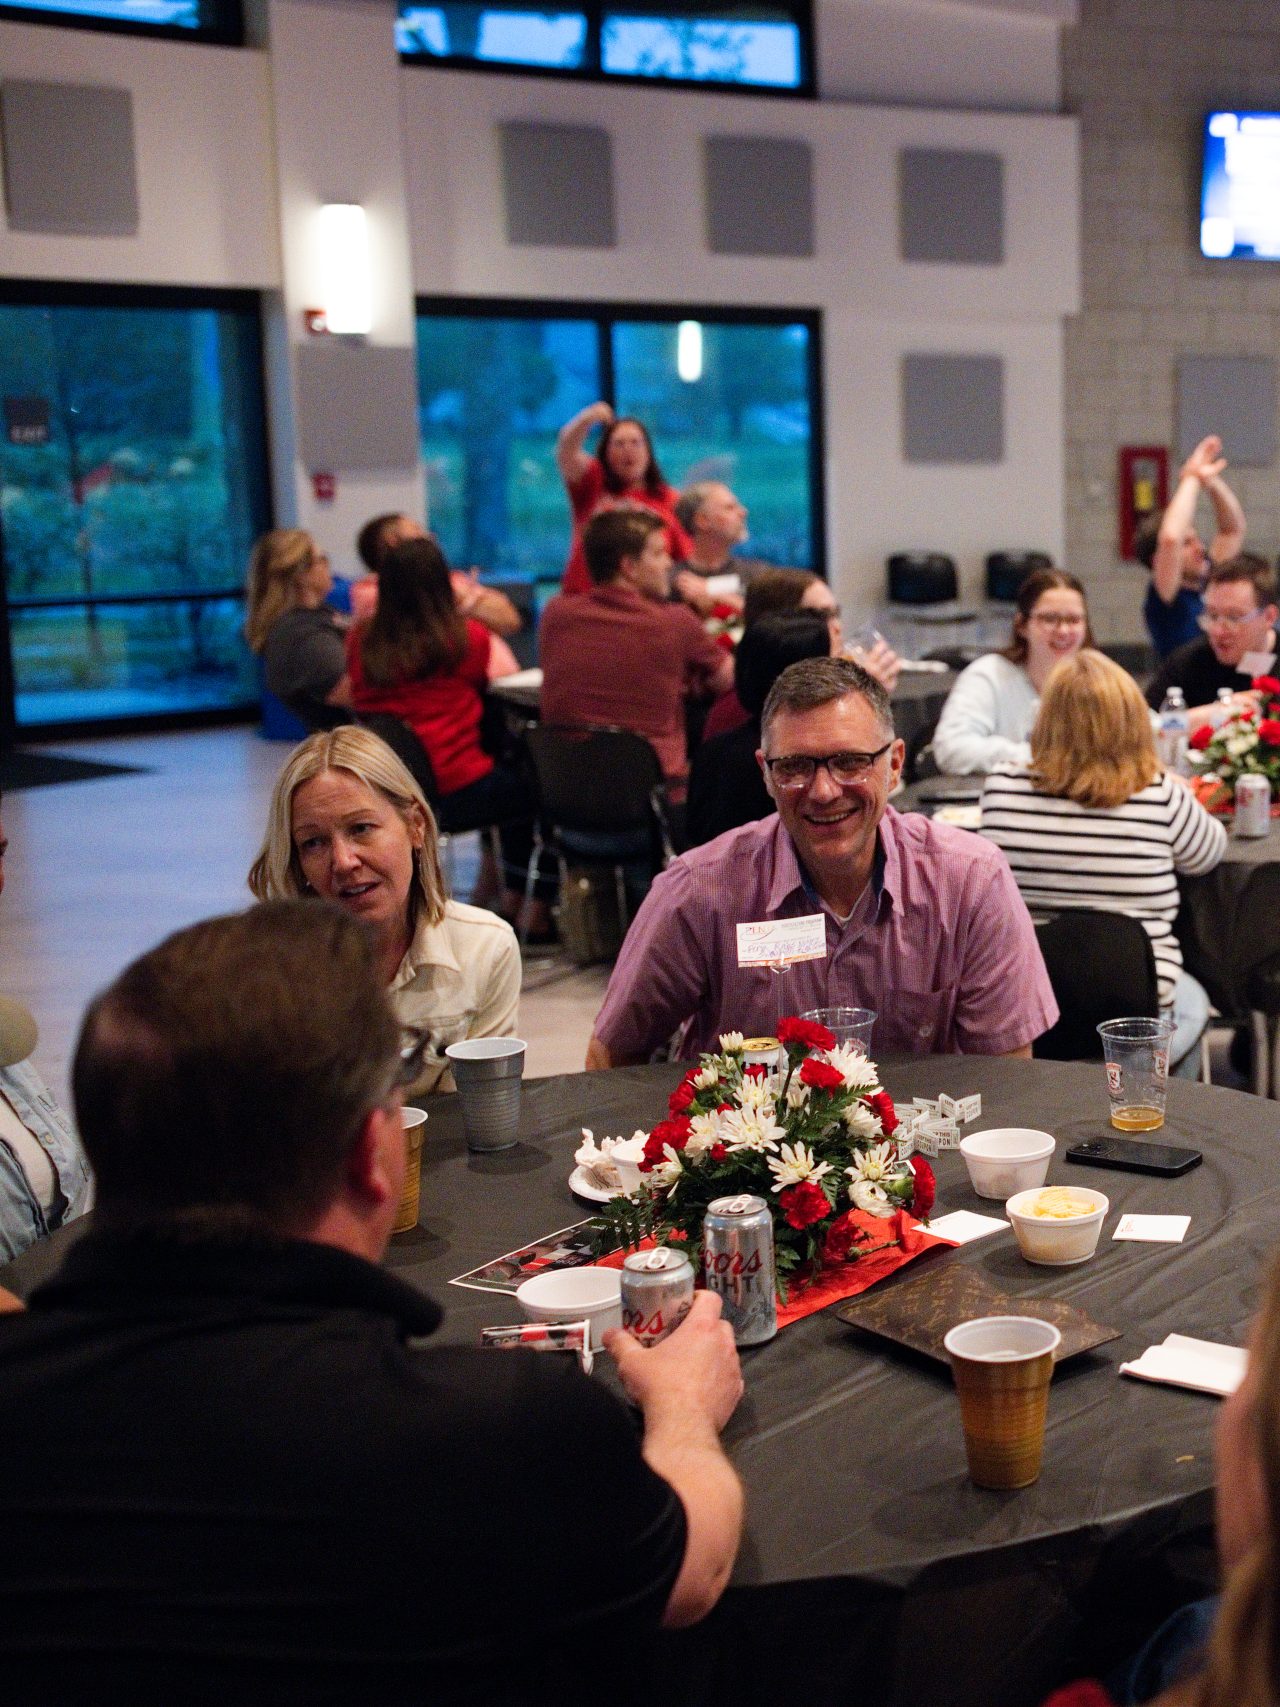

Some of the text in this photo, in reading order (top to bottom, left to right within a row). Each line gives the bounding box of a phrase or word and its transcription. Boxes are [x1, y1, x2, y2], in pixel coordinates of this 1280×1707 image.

[705, 1248, 763, 1275] oors
[709, 1274, 755, 1295] GHT
[622, 1308, 667, 1335] ors
